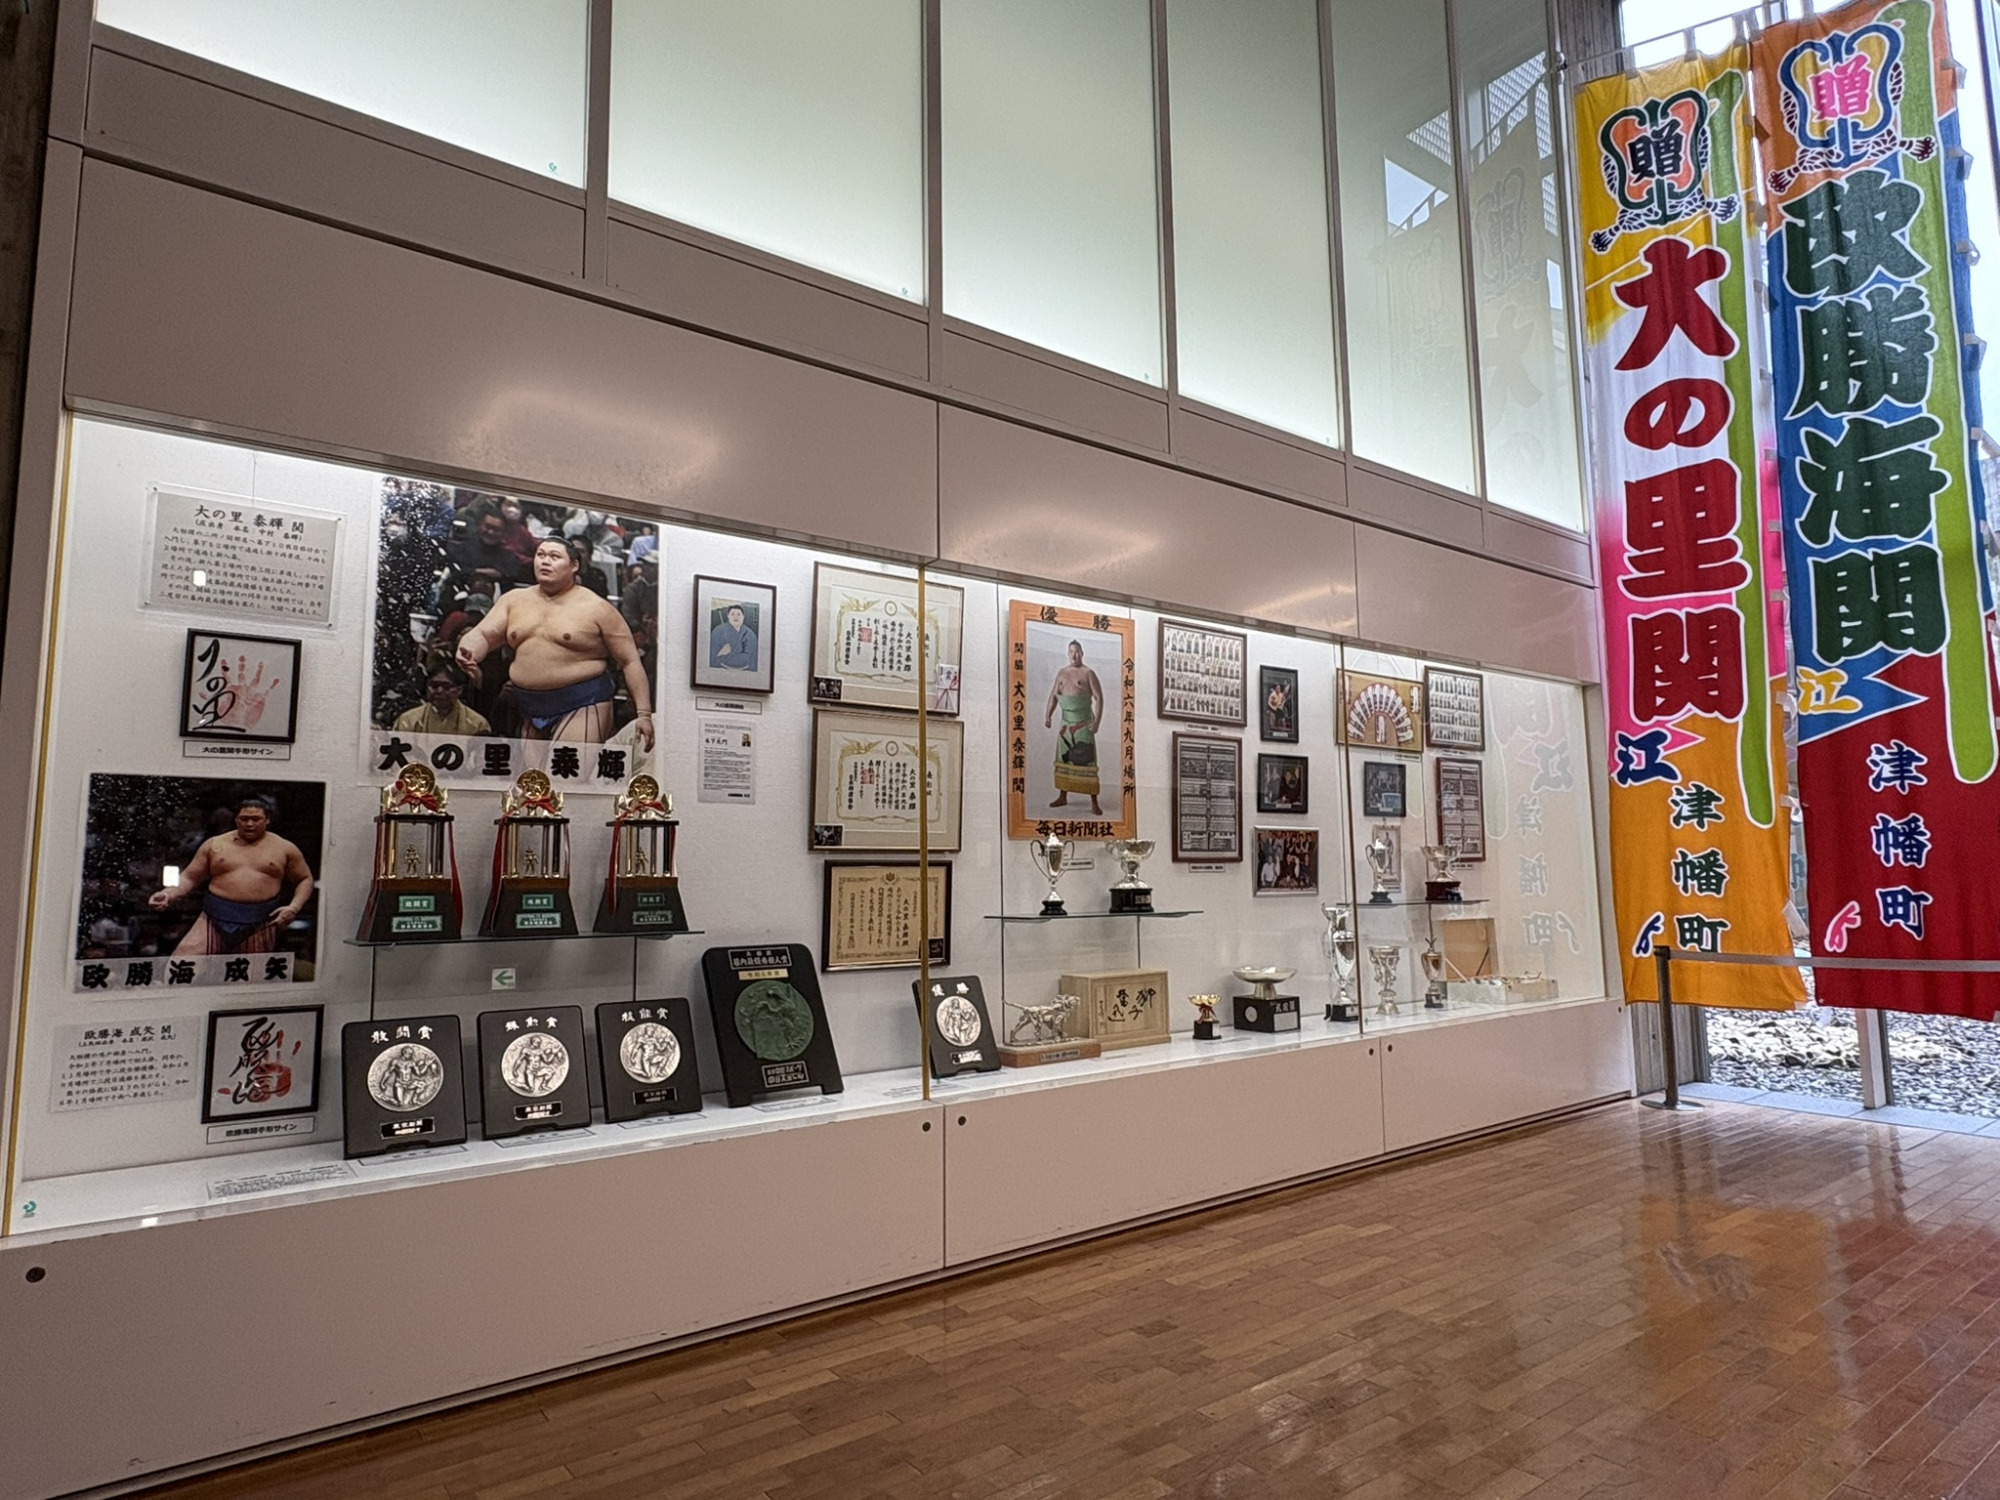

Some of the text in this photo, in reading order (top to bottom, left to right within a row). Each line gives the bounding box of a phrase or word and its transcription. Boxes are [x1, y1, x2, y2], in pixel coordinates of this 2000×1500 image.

[1808, 54, 1872, 121] 贈
[1627, 121, 1684, 182] 贈
[194, 504, 244, 523] 大の里
[253, 513, 284, 531] 泰輝
[1039, 606, 1111, 631] 優勝
[1012, 681, 1025, 731] 大の里
[1123, 658, 1135, 797] 令和六年九月場所
[202, 747, 273, 755] 大の里関手形サイン
[378, 737, 626, 782] 大の里 泰輝
[1012, 741, 1025, 769] 泰輝
[1012, 777, 1025, 794] 関
[1035, 820, 1115, 839] 毎日新聞社
[1867, 740, 1932, 940] 津幡町
[1669, 781, 1731, 953] 津幡町
[82, 957, 288, 988] 欧勝海 成矢
[621, 1006, 669, 1023] 技能賞
[84, 1028, 124, 1040] 欧勝海
[130, 1026, 155, 1038] 成矢
[371, 1025, 433, 1044] 敢闘賞
